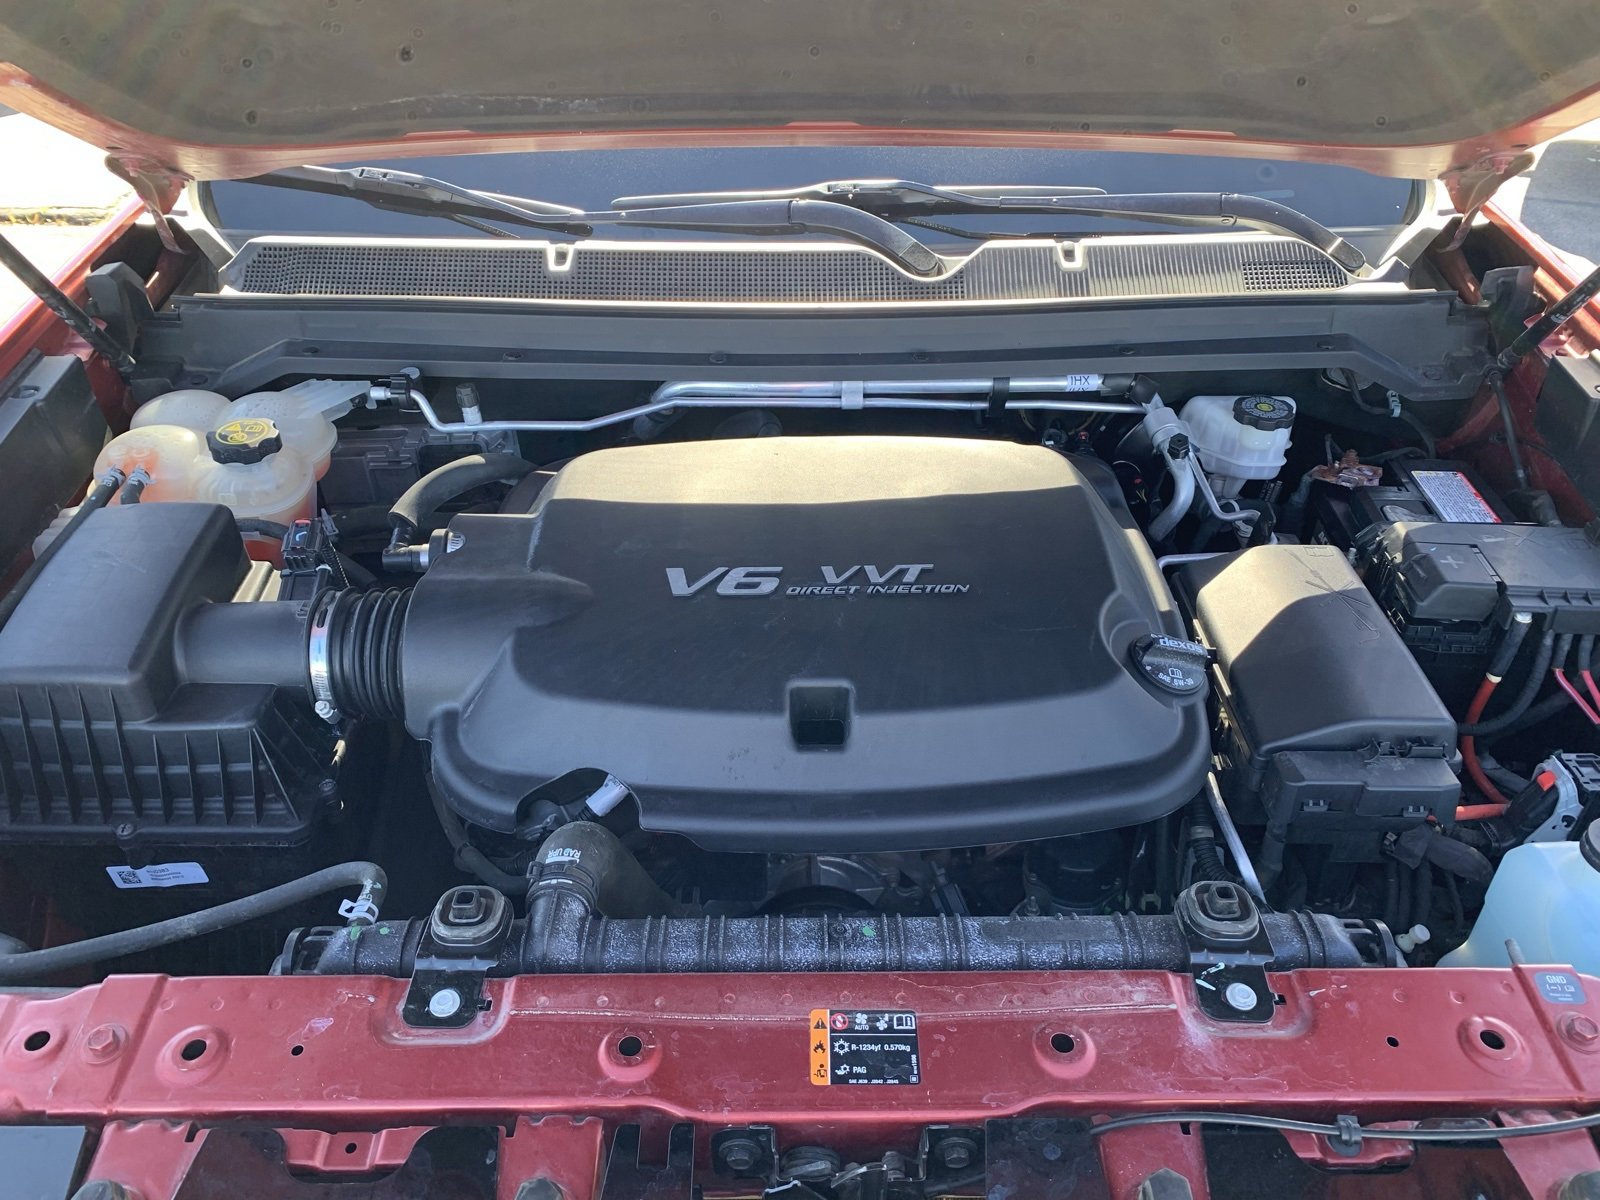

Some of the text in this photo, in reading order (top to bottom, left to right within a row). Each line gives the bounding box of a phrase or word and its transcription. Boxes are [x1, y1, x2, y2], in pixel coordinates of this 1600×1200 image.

[665, 563, 934, 597] V6 VVT
[785, 583, 970, 596] DIRECT INJECTION
[1159, 637, 1203, 653] dexos
[1157, 672, 1172, 683] SAE
[563, 847, 581, 857] RAD
[1546, 975, 1567, 984] GND
[851, 1044, 911, 1052] R-1234yf 0.570kg
[852, 1066, 866, 1074] PAG
